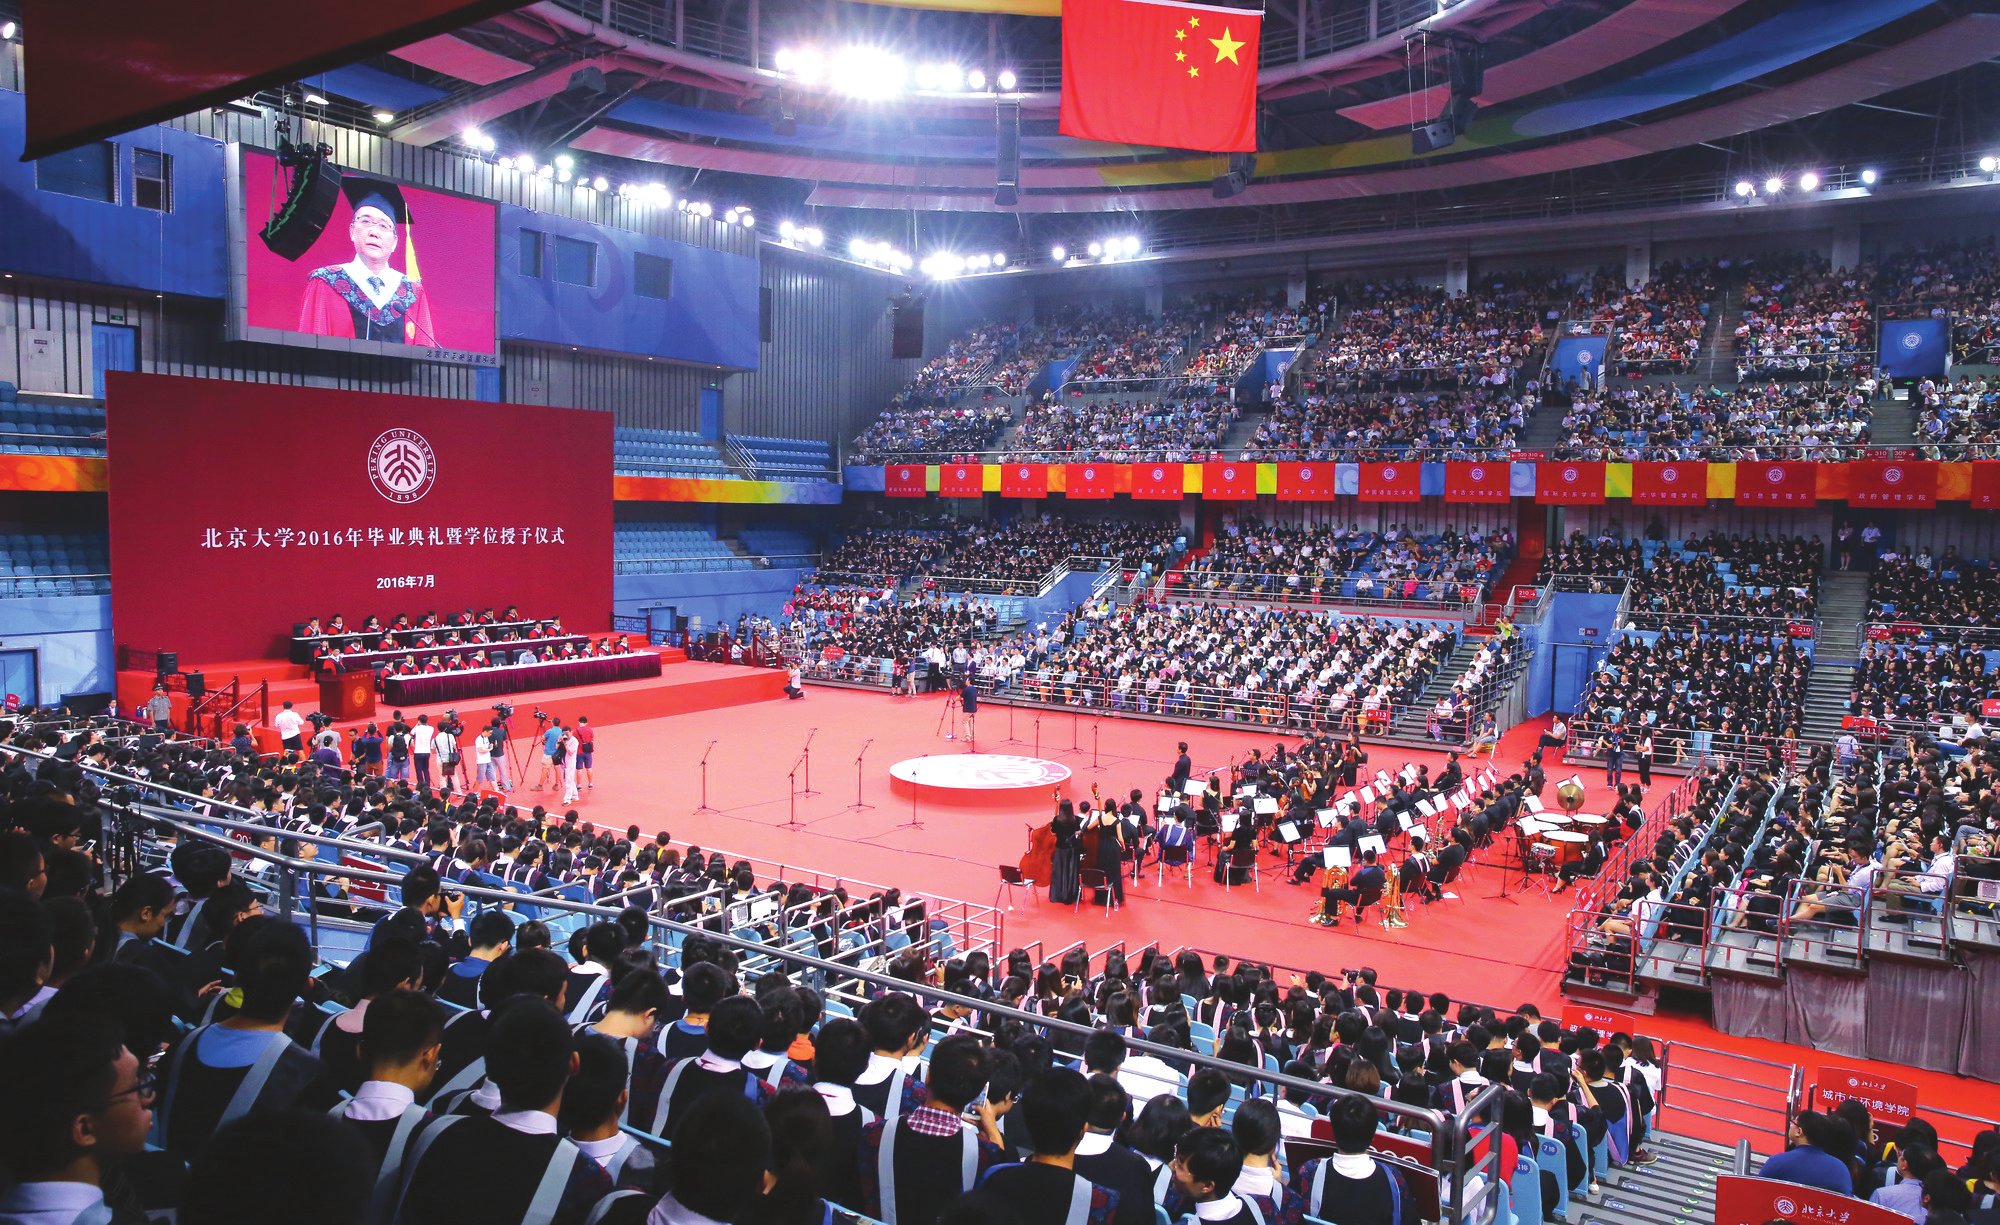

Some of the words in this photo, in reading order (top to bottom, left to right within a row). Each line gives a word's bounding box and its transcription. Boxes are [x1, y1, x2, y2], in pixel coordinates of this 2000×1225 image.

[371, 436, 388, 480] PEKING
[391, 430, 434, 481] UNIVERSITY
[389, 492, 418, 501] 1898
[1743, 492, 1807, 500] 信息管理系
[1858, 493, 1926, 501] 政府管理学院
[200, 526, 565, 549] 北京大学2016年毕业典礼暨学位授予仪式
[376, 574, 436, 590] 2016年7月
[1801, 1203, 1850, 1224] 北京大学
